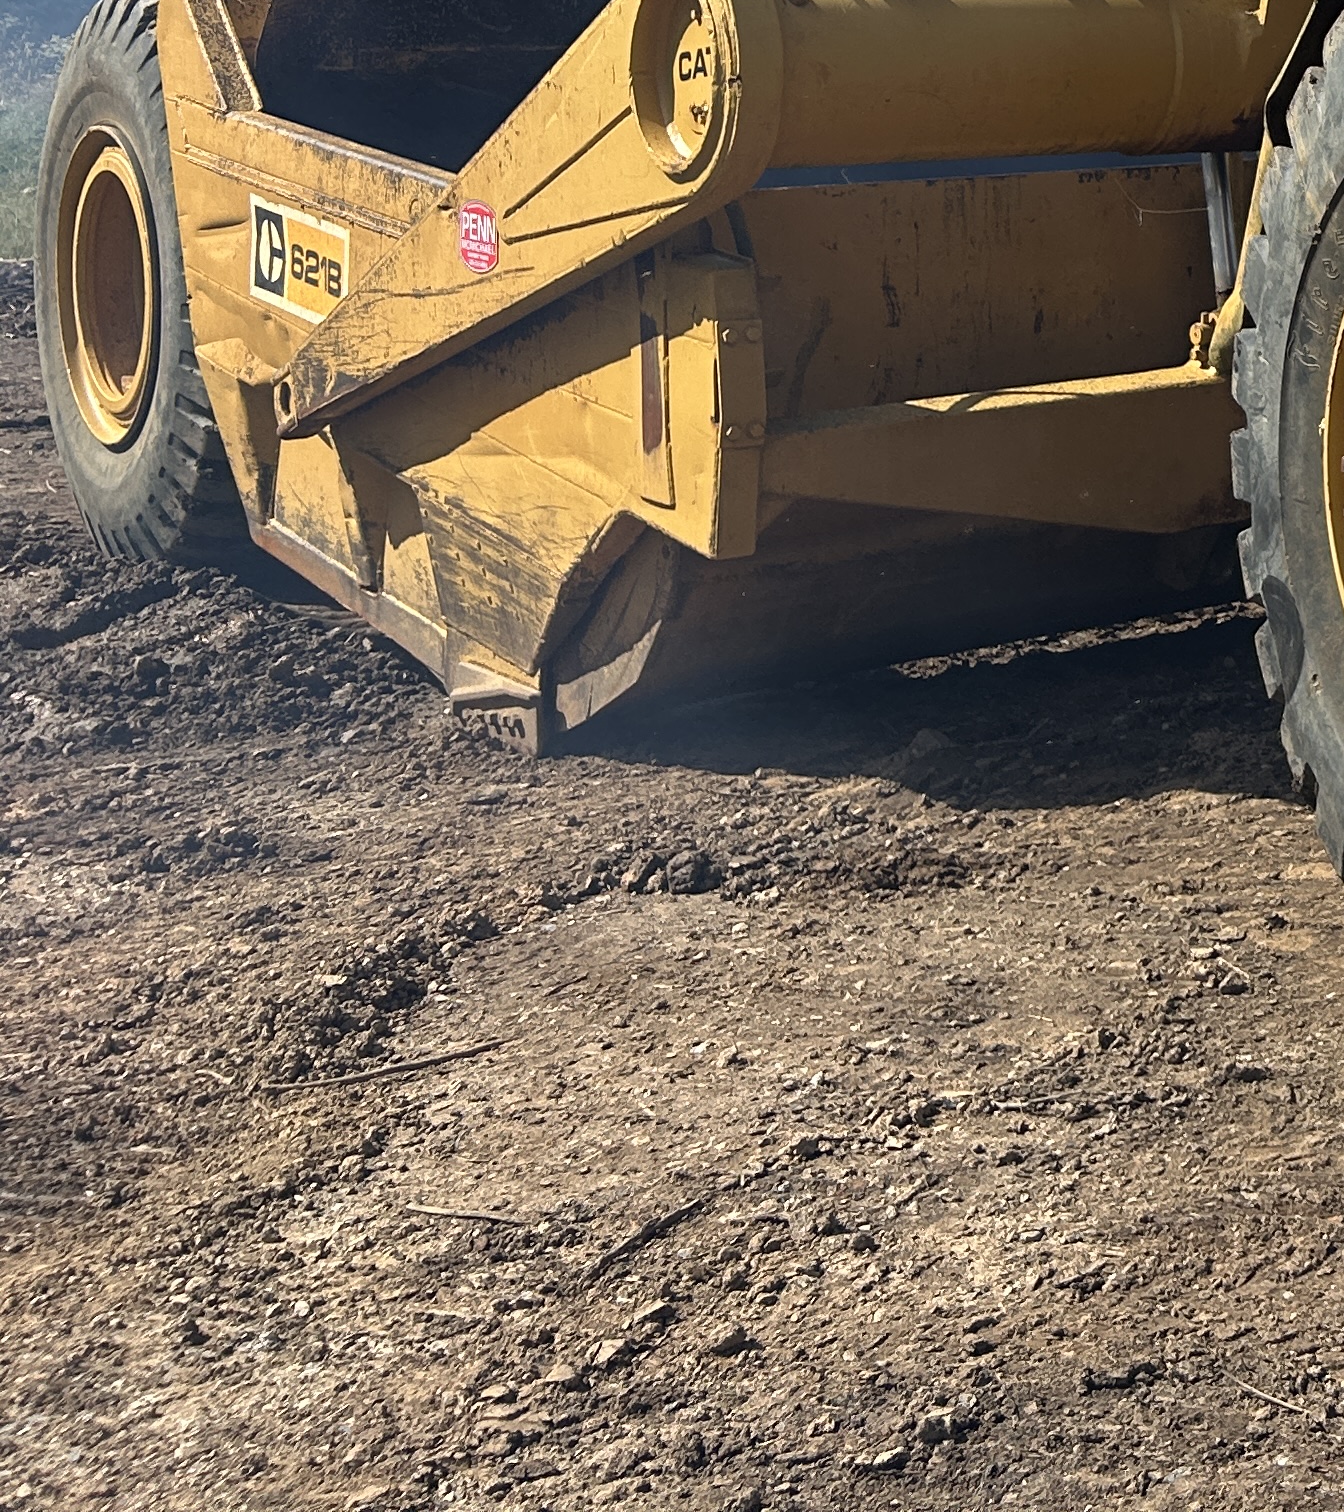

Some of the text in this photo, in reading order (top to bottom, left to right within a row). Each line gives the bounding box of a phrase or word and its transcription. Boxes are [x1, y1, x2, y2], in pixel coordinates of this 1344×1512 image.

[678, 46, 712, 82] CA
[460, 211, 496, 244] PENN
[291, 243, 342, 299] 621B
